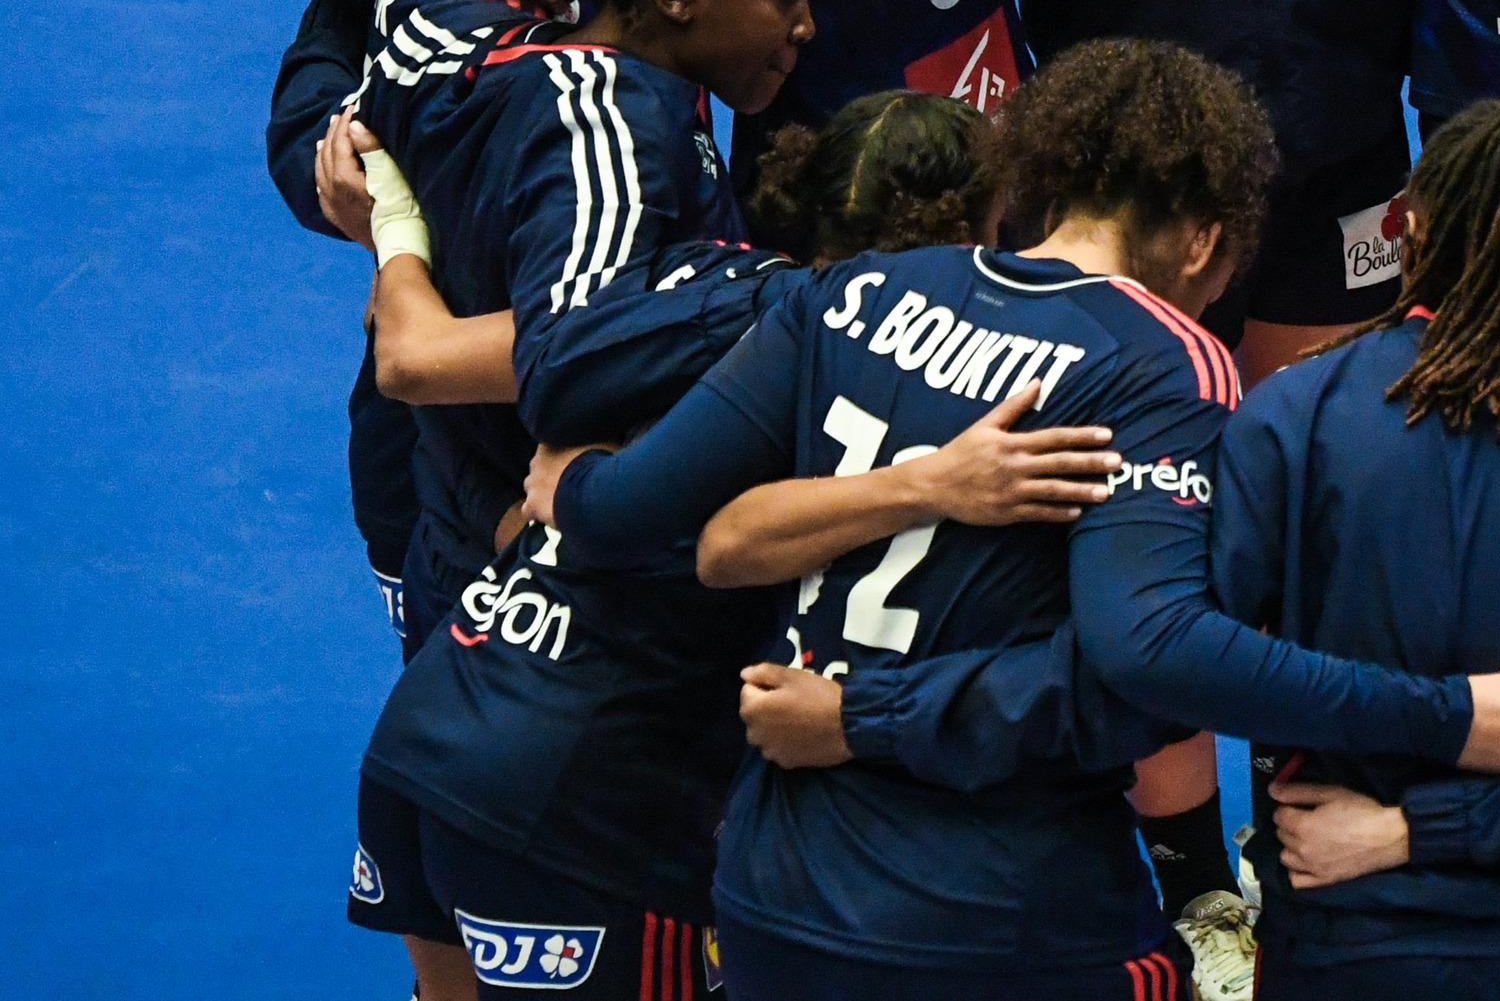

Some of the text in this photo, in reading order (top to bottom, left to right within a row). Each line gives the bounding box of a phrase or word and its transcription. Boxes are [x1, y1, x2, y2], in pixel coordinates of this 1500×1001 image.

[822, 271, 1086, 412] S. BOUKTIT
[1107, 456, 1213, 504] préfo
